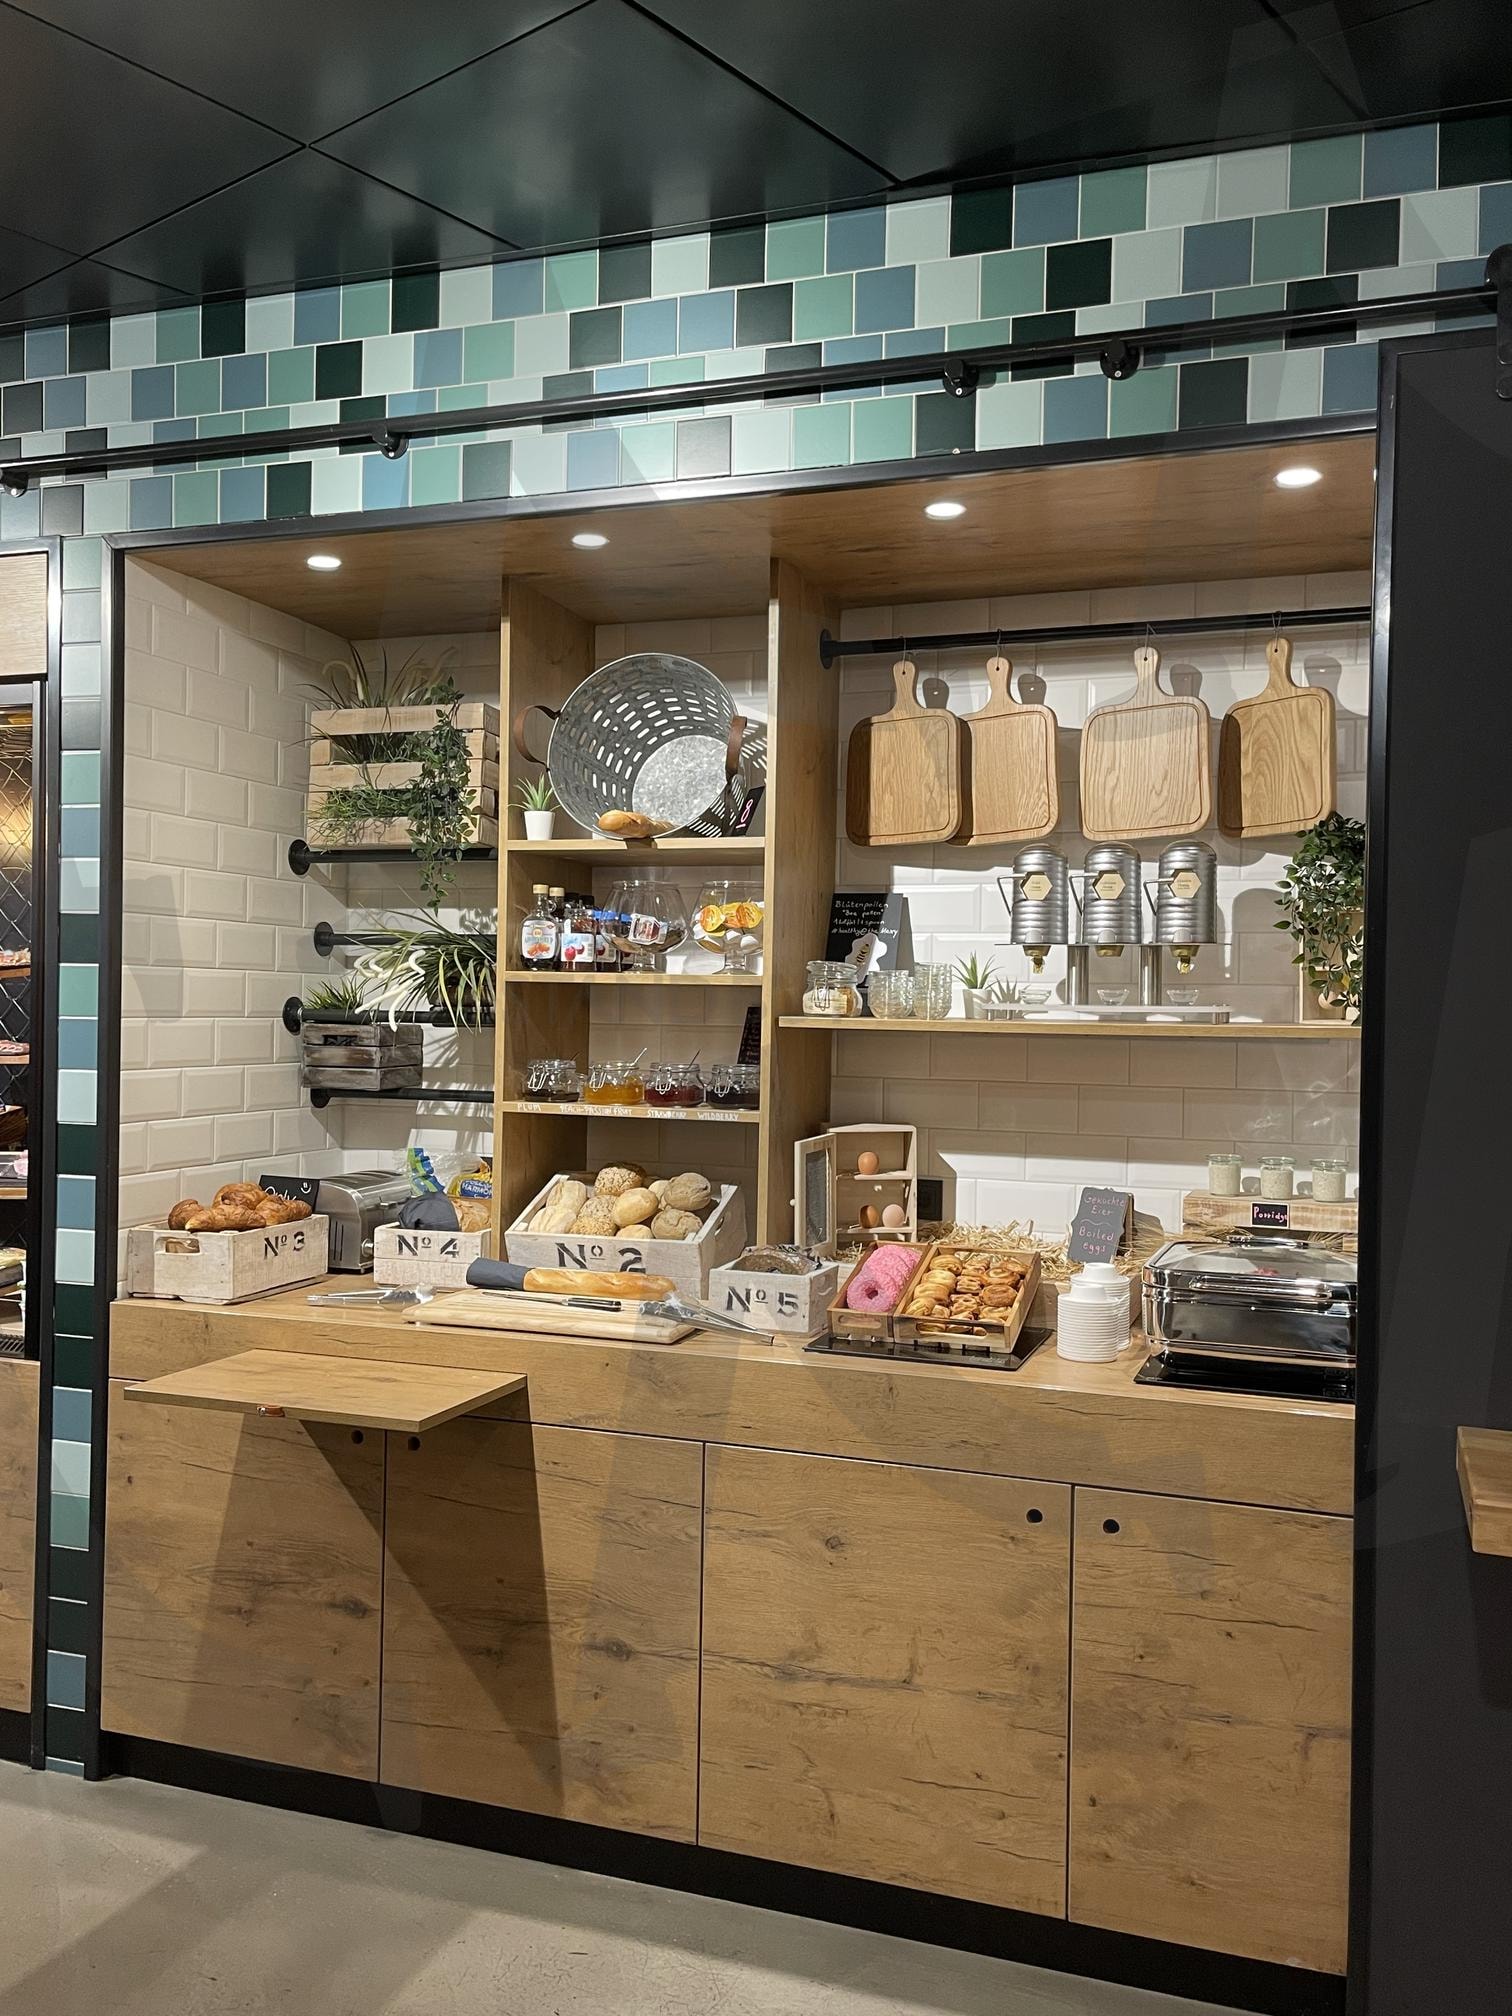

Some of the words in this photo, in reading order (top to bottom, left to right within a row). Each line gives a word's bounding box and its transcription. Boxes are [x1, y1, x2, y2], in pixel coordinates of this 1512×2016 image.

[517, 1103, 542, 1113] PLUM
[697, 1111, 739, 1122] WILDBERRY
[1084, 1192, 1126, 1207] Gekochte
[1091, 1205, 1113, 1216] Eier
[1078, 1226, 1114, 1241] Boiled
[293, 1231, 305, 1252] 3
[439, 1238, 460, 1259] 4
[1082, 1241, 1106, 1255] eggs
[618, 1247, 646, 1274] 2
[777, 1291, 799, 1317] 5
